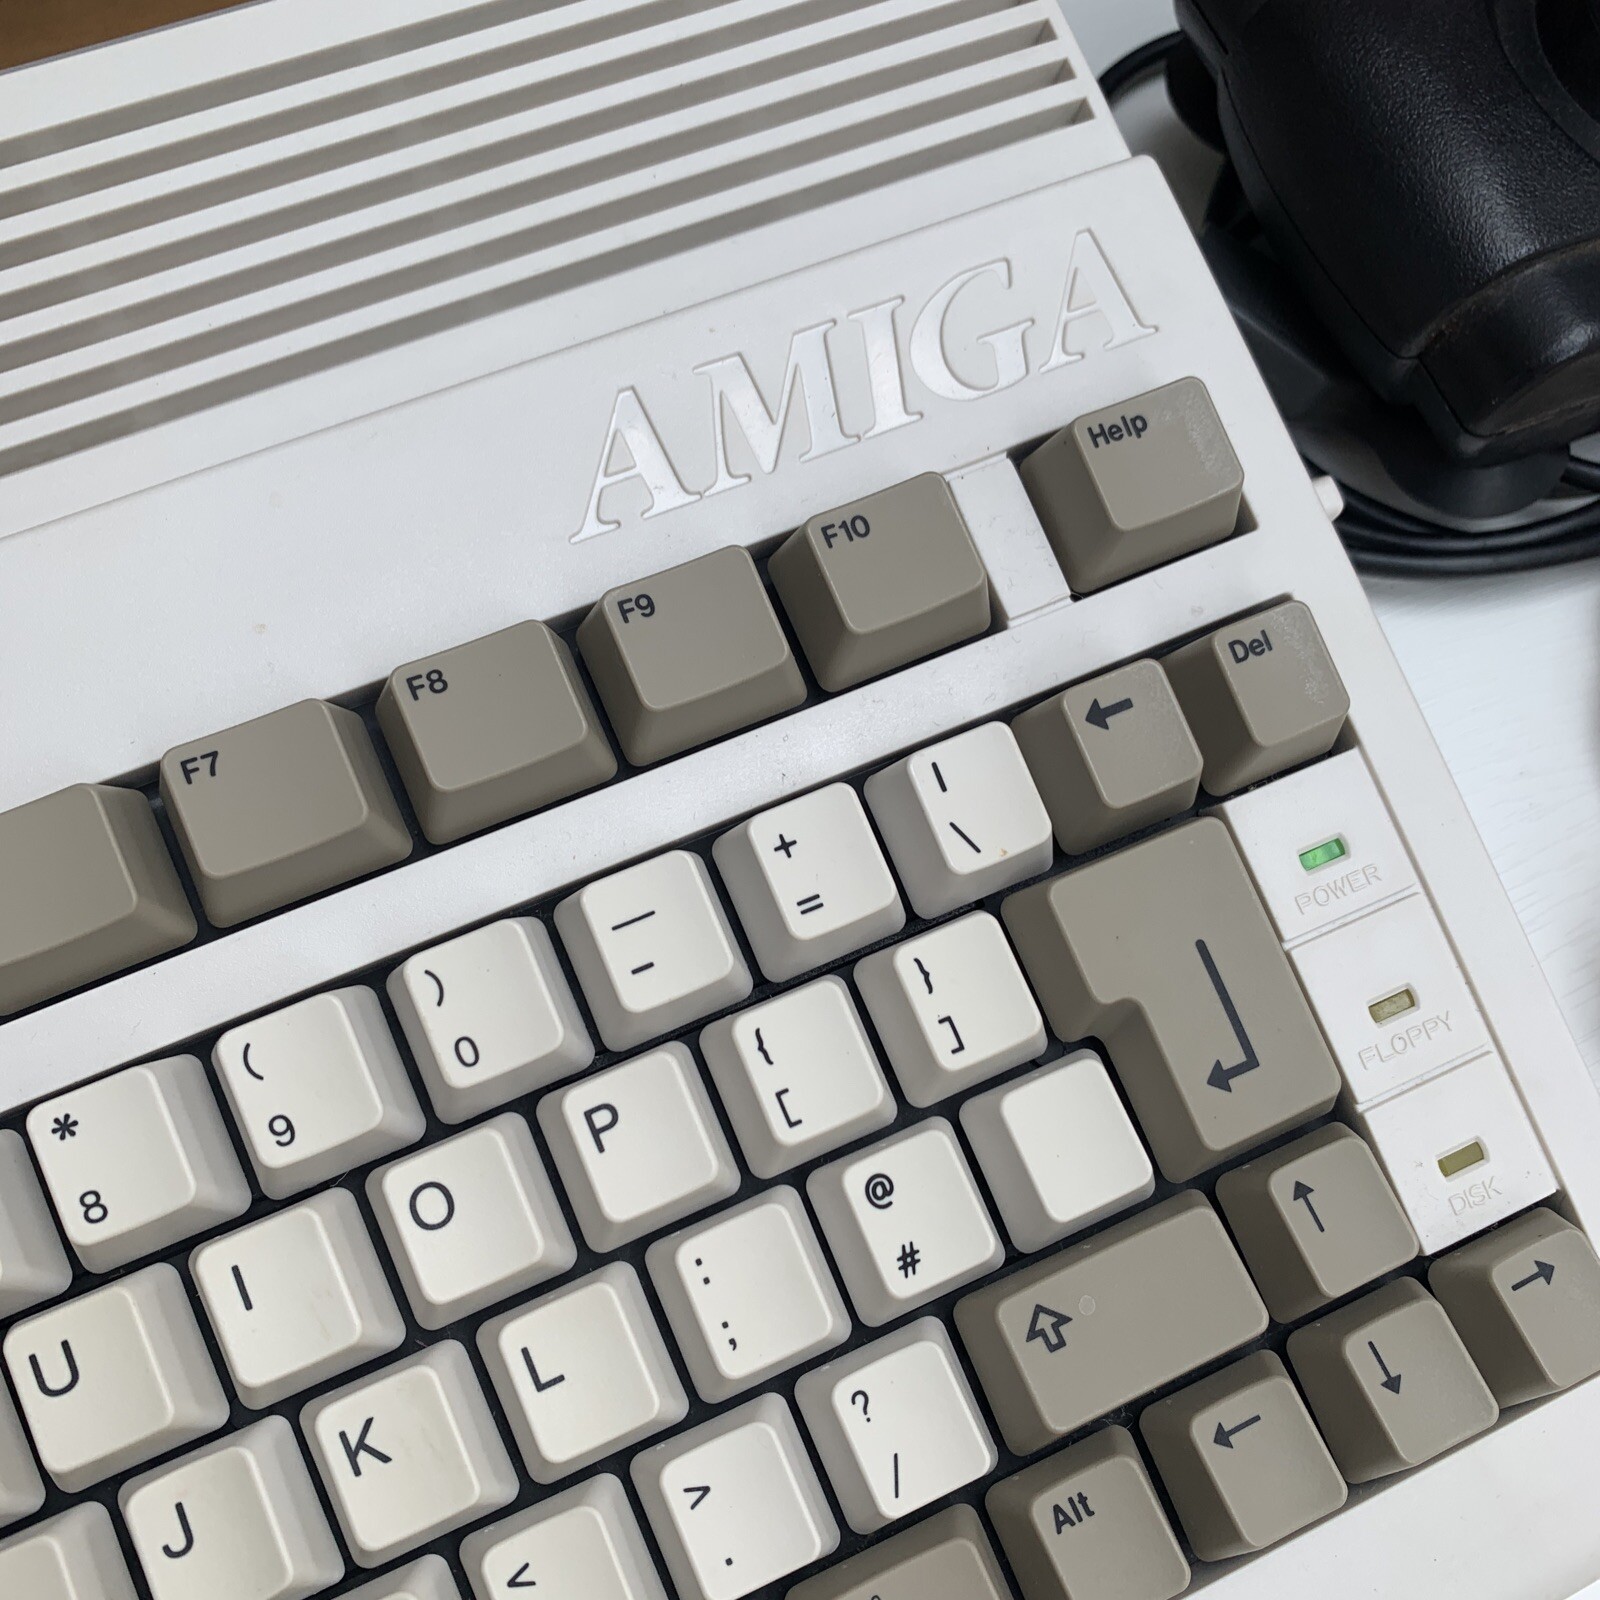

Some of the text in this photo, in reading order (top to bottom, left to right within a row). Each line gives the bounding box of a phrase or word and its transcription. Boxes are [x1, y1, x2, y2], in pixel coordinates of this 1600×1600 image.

[569, 227, 1159, 544] AMIGA
[1086, 414, 1148, 449] Help
[820, 514, 871, 549] F10
[617, 593, 656, 624] F9
[1229, 634, 1273, 664] Del
[405, 669, 449, 702] F8
[180, 750, 219, 785] F7
[1294, 864, 1382, 915] POWER
[1358, 1010, 1454, 1070] FLOPPY
[268, 1114, 296, 1147] 9
[584, 1103, 619, 1154] P
[79, 1190, 109, 1224] 8
[409, 1181, 455, 1231] O
[1447, 1176, 1503, 1216] DISK
[231, 1264, 253, 1311] I
[28, 1339, 80, 1398] U
[521, 1346, 566, 1393] L
[338, 1416, 393, 1478] K
[162, 1501, 194, 1559] J
[1052, 1491, 1096, 1535] Alt
